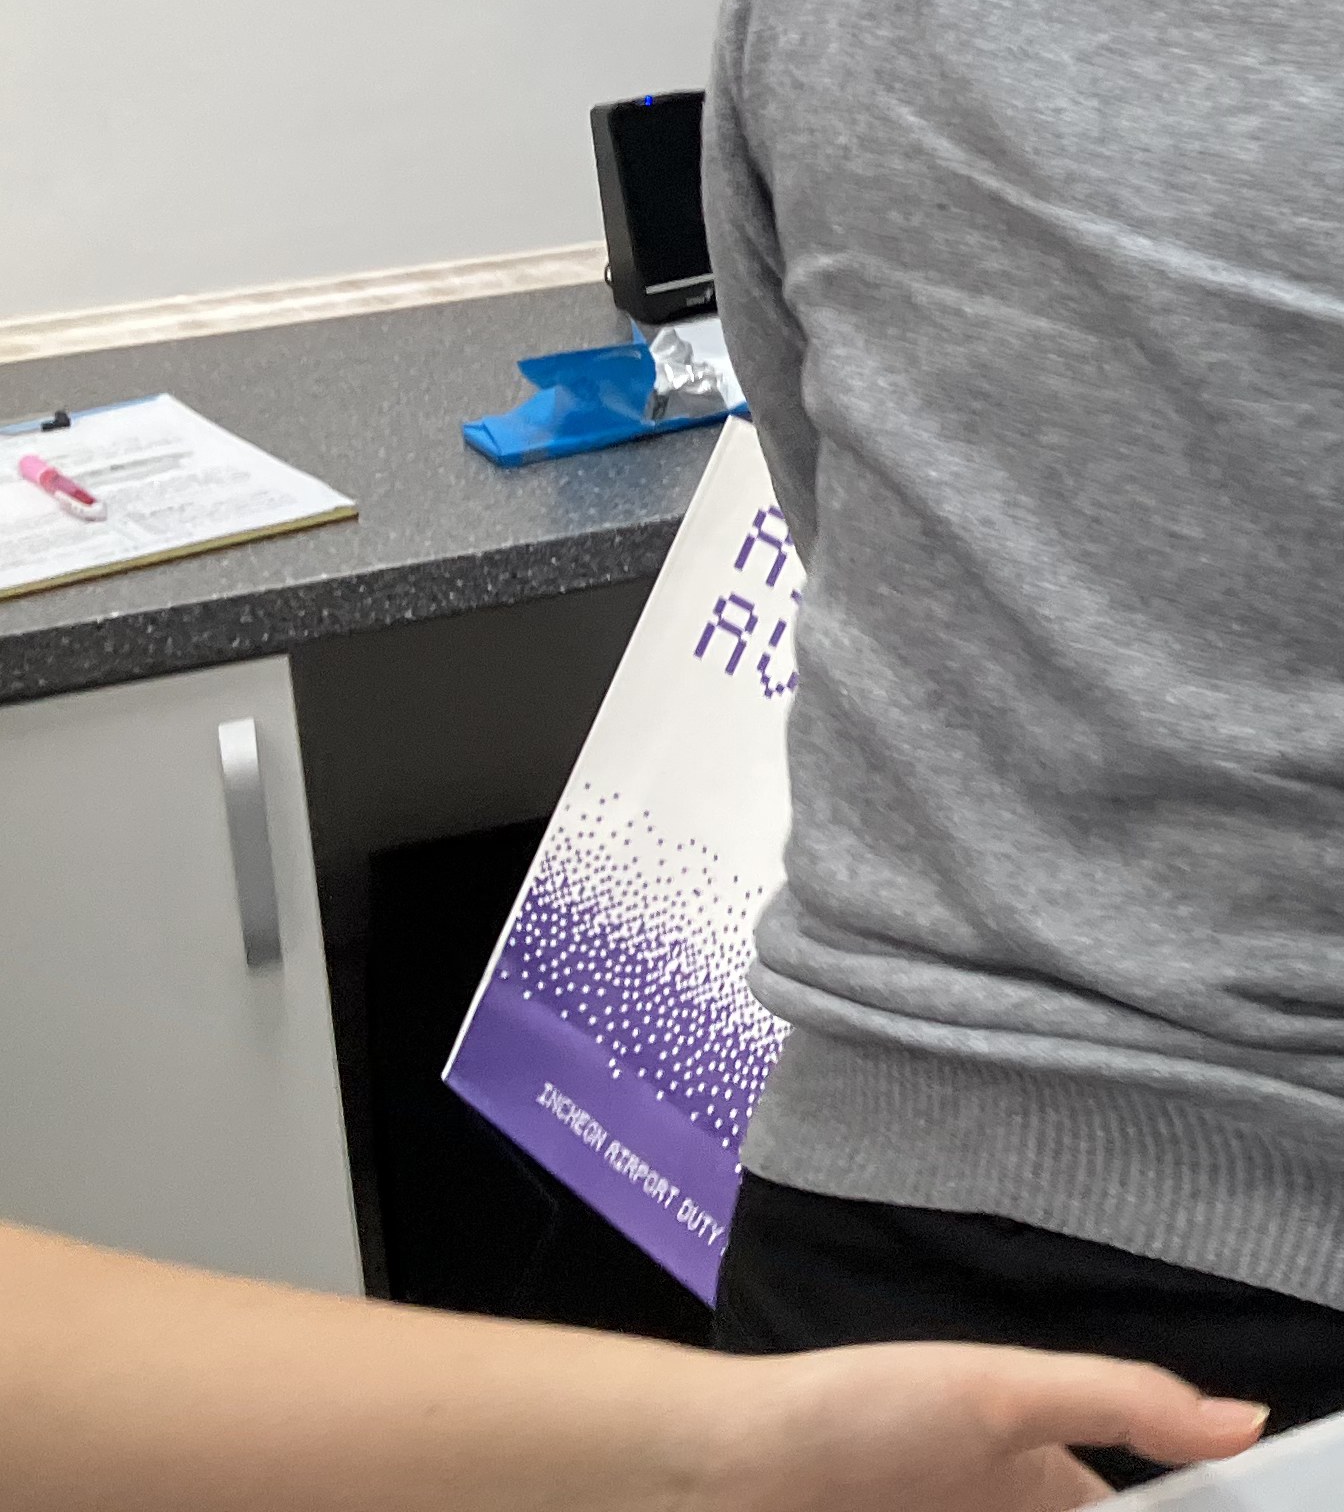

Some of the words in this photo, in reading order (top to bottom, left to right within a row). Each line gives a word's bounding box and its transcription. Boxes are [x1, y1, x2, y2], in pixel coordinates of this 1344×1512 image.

[536, 1082, 608, 1152] INCHEON
[603, 1139, 681, 1209] AIRPORT
[676, 1197, 725, 1246] DUTY
